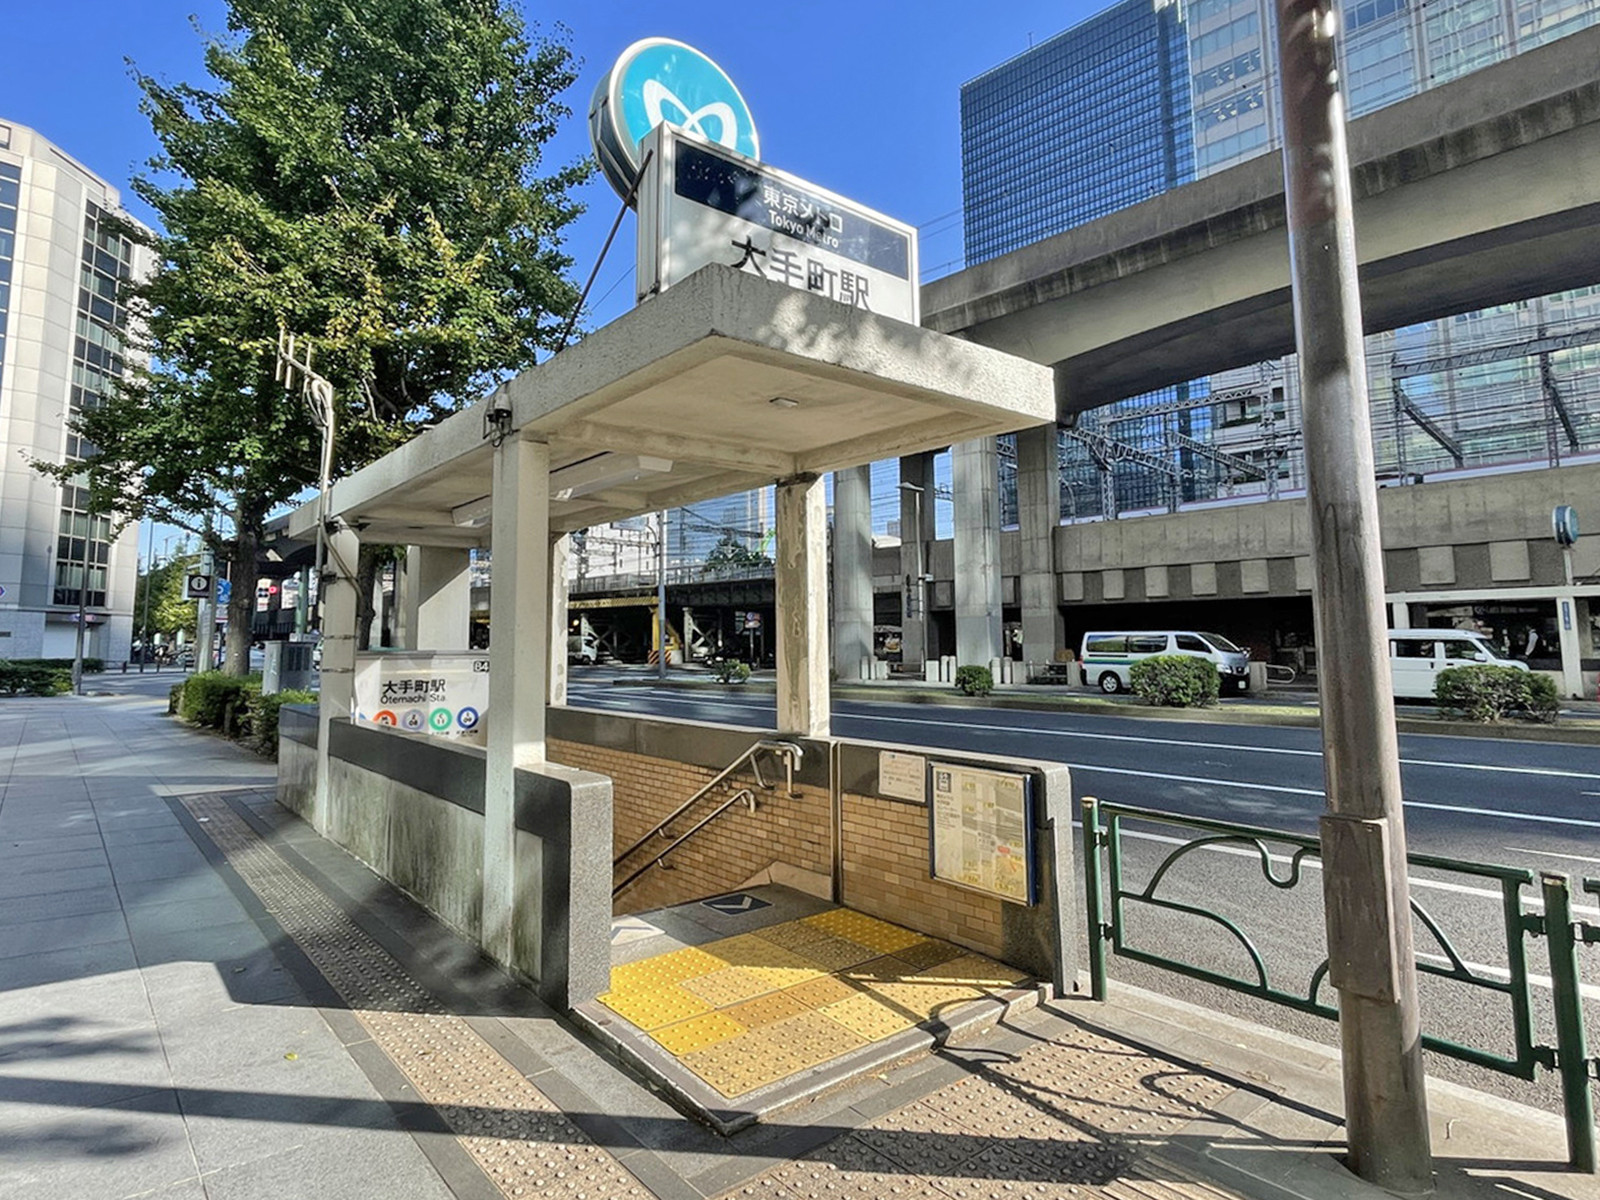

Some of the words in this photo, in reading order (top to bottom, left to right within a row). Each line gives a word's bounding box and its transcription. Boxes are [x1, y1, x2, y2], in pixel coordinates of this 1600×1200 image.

[763, 185, 843, 233] 東京メトロ
[768, 209, 804, 234] Tokyo
[806, 224, 839, 249] Metro
[730, 235, 871, 312] 大手町駅
[382, 679, 446, 695] 大手町駅
